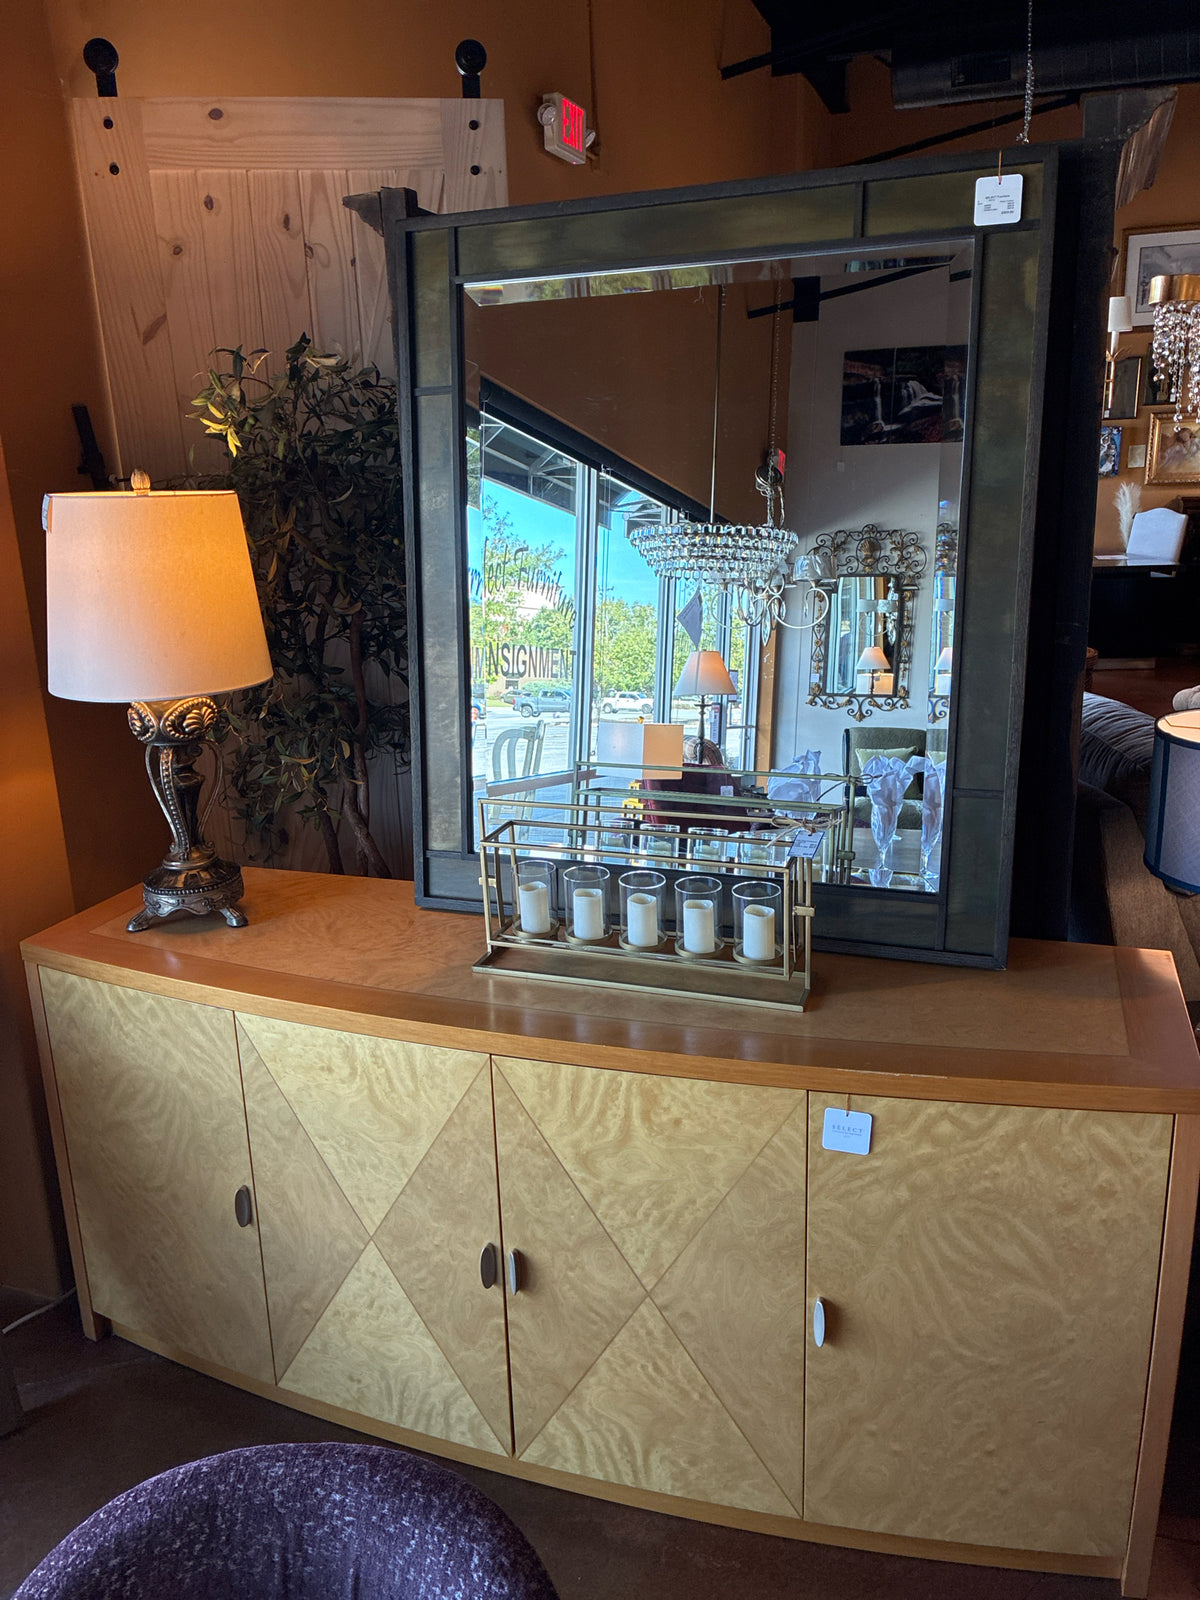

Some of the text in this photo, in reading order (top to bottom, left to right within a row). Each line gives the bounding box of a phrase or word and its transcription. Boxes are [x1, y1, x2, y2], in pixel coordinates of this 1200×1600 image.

[562, 98, 584, 152] EXIT
[514, 545, 577, 630] Furniture
[832, 1125, 863, 1133] SELECT
